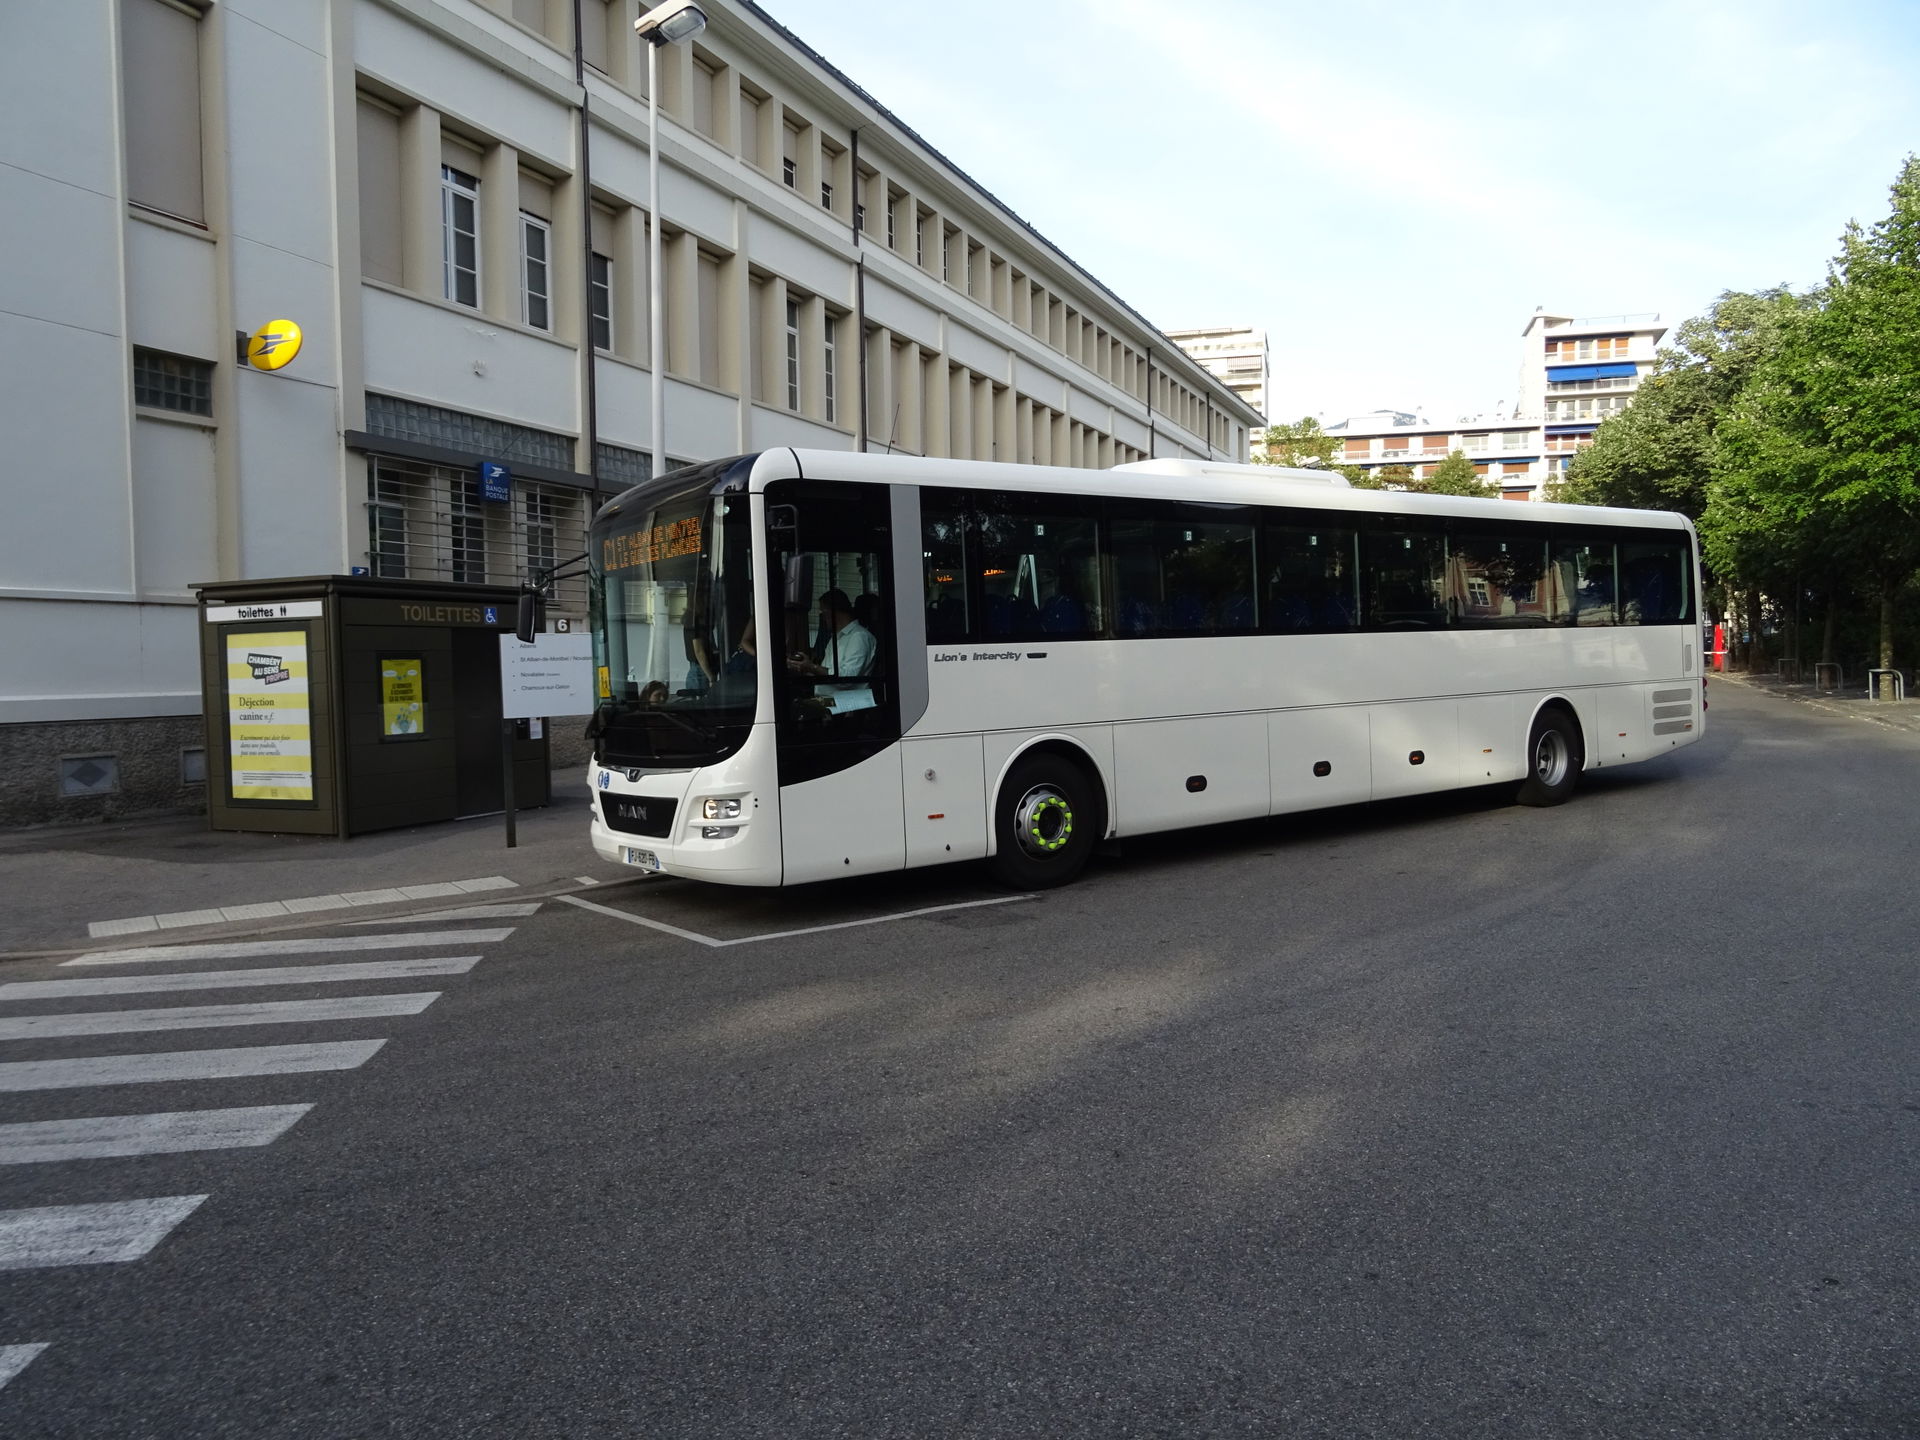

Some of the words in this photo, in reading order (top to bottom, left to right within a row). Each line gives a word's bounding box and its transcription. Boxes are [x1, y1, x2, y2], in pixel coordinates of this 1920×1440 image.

[485, 485, 508, 494] BANQUE
[485, 491, 509, 501] POSTALE
[238, 606, 274, 618] toilettes
[400, 605, 481, 623] TOILETTES
[557, 619, 568, 631] 6
[934, 652, 967, 662] Lion's
[972, 651, 1021, 661] Intercity
[263, 666, 280, 675] SENS
[266, 670, 289, 683] PROPRE
[239, 697, 274, 709] Déjection
[239, 712, 263, 721] canine
[618, 803, 647, 820] MAN
